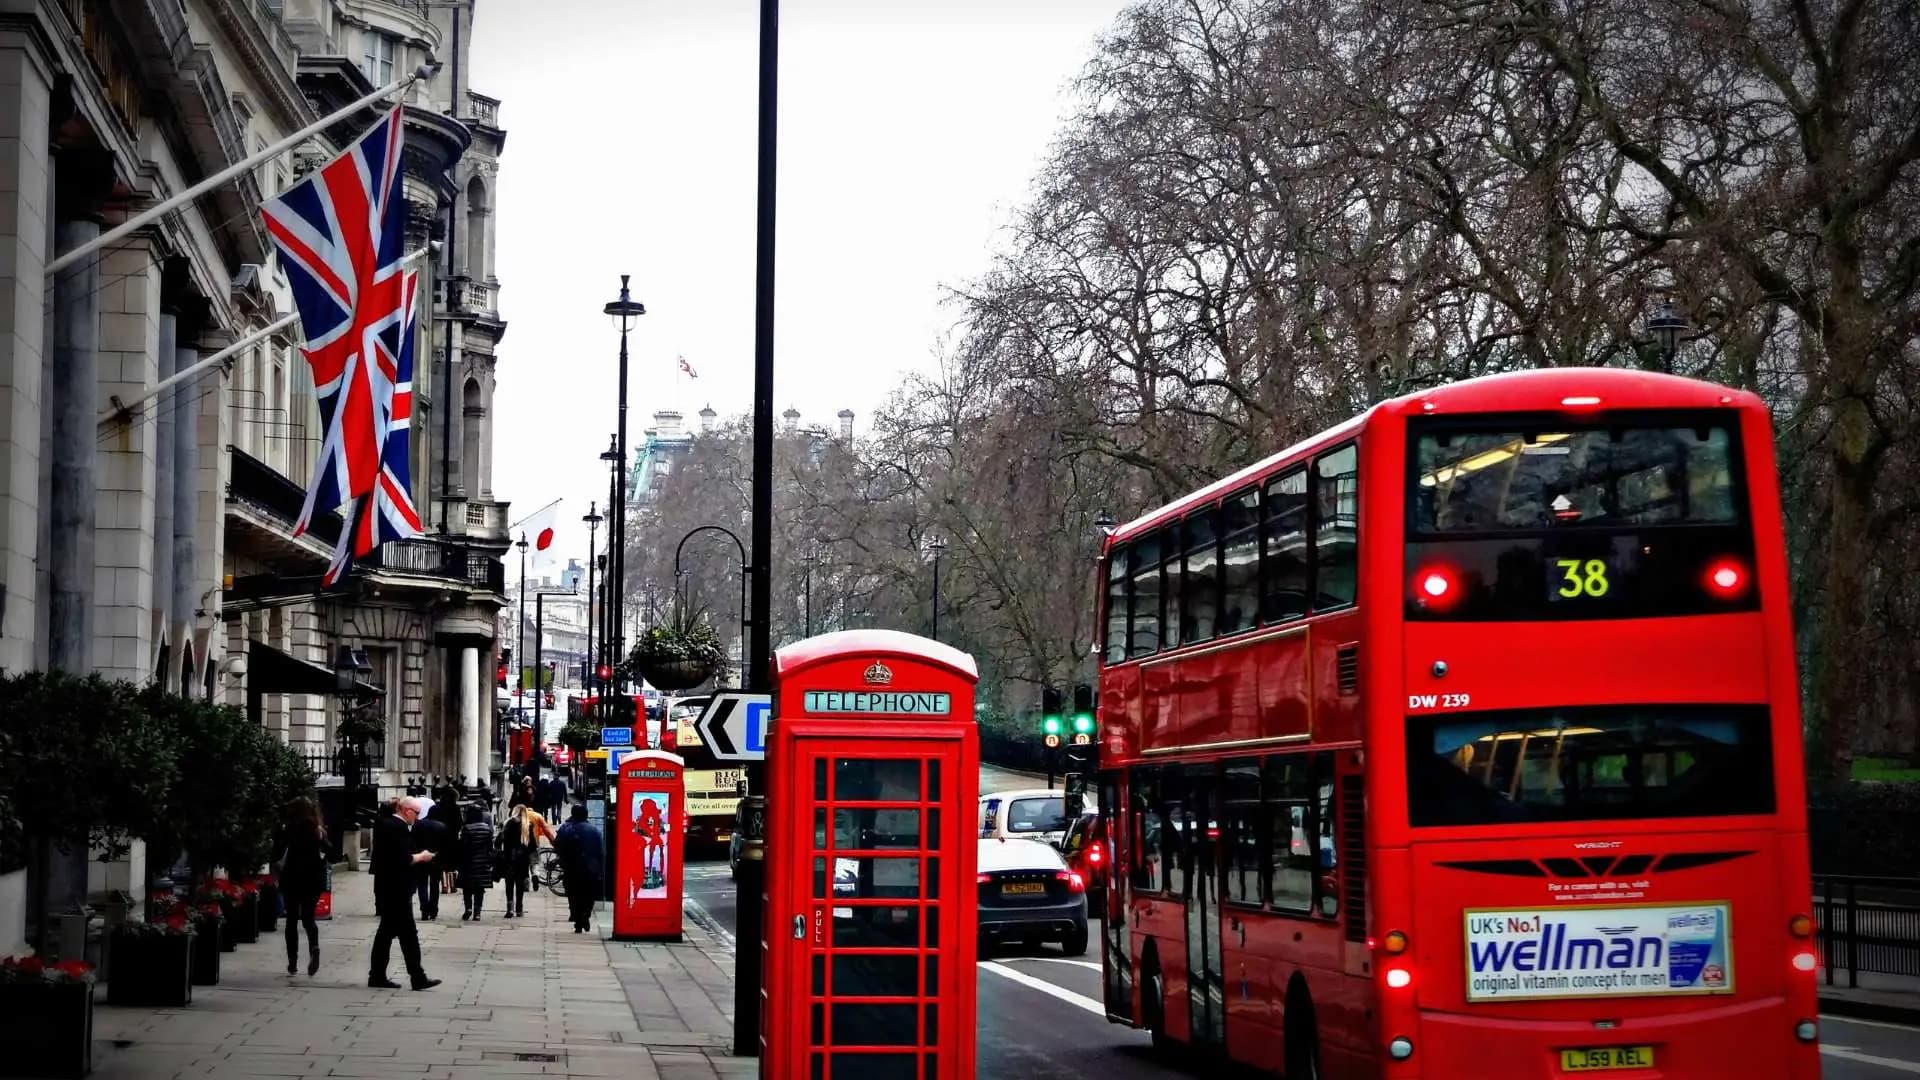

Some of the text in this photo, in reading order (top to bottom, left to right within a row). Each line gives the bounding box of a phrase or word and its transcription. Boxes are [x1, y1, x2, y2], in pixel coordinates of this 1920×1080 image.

[1557, 559, 1609, 598] 38
[809, 692, 945, 713] TELEPHONE
[1408, 693, 1470, 708] DW 239
[629, 770, 674, 778] TELEPHONE
[1548, 883, 1562, 891] For
[1571, 883, 1598, 891] career
[1599, 881, 1617, 889] with
[1632, 880, 1650, 888] visit
[1471, 915, 1541, 934] UK's No.1
[1470, 923, 1662, 972] wellman
[1473, 970, 1667, 994] original vitamin concept for men
[1567, 1051, 1647, 1069] LJ59 AEL
